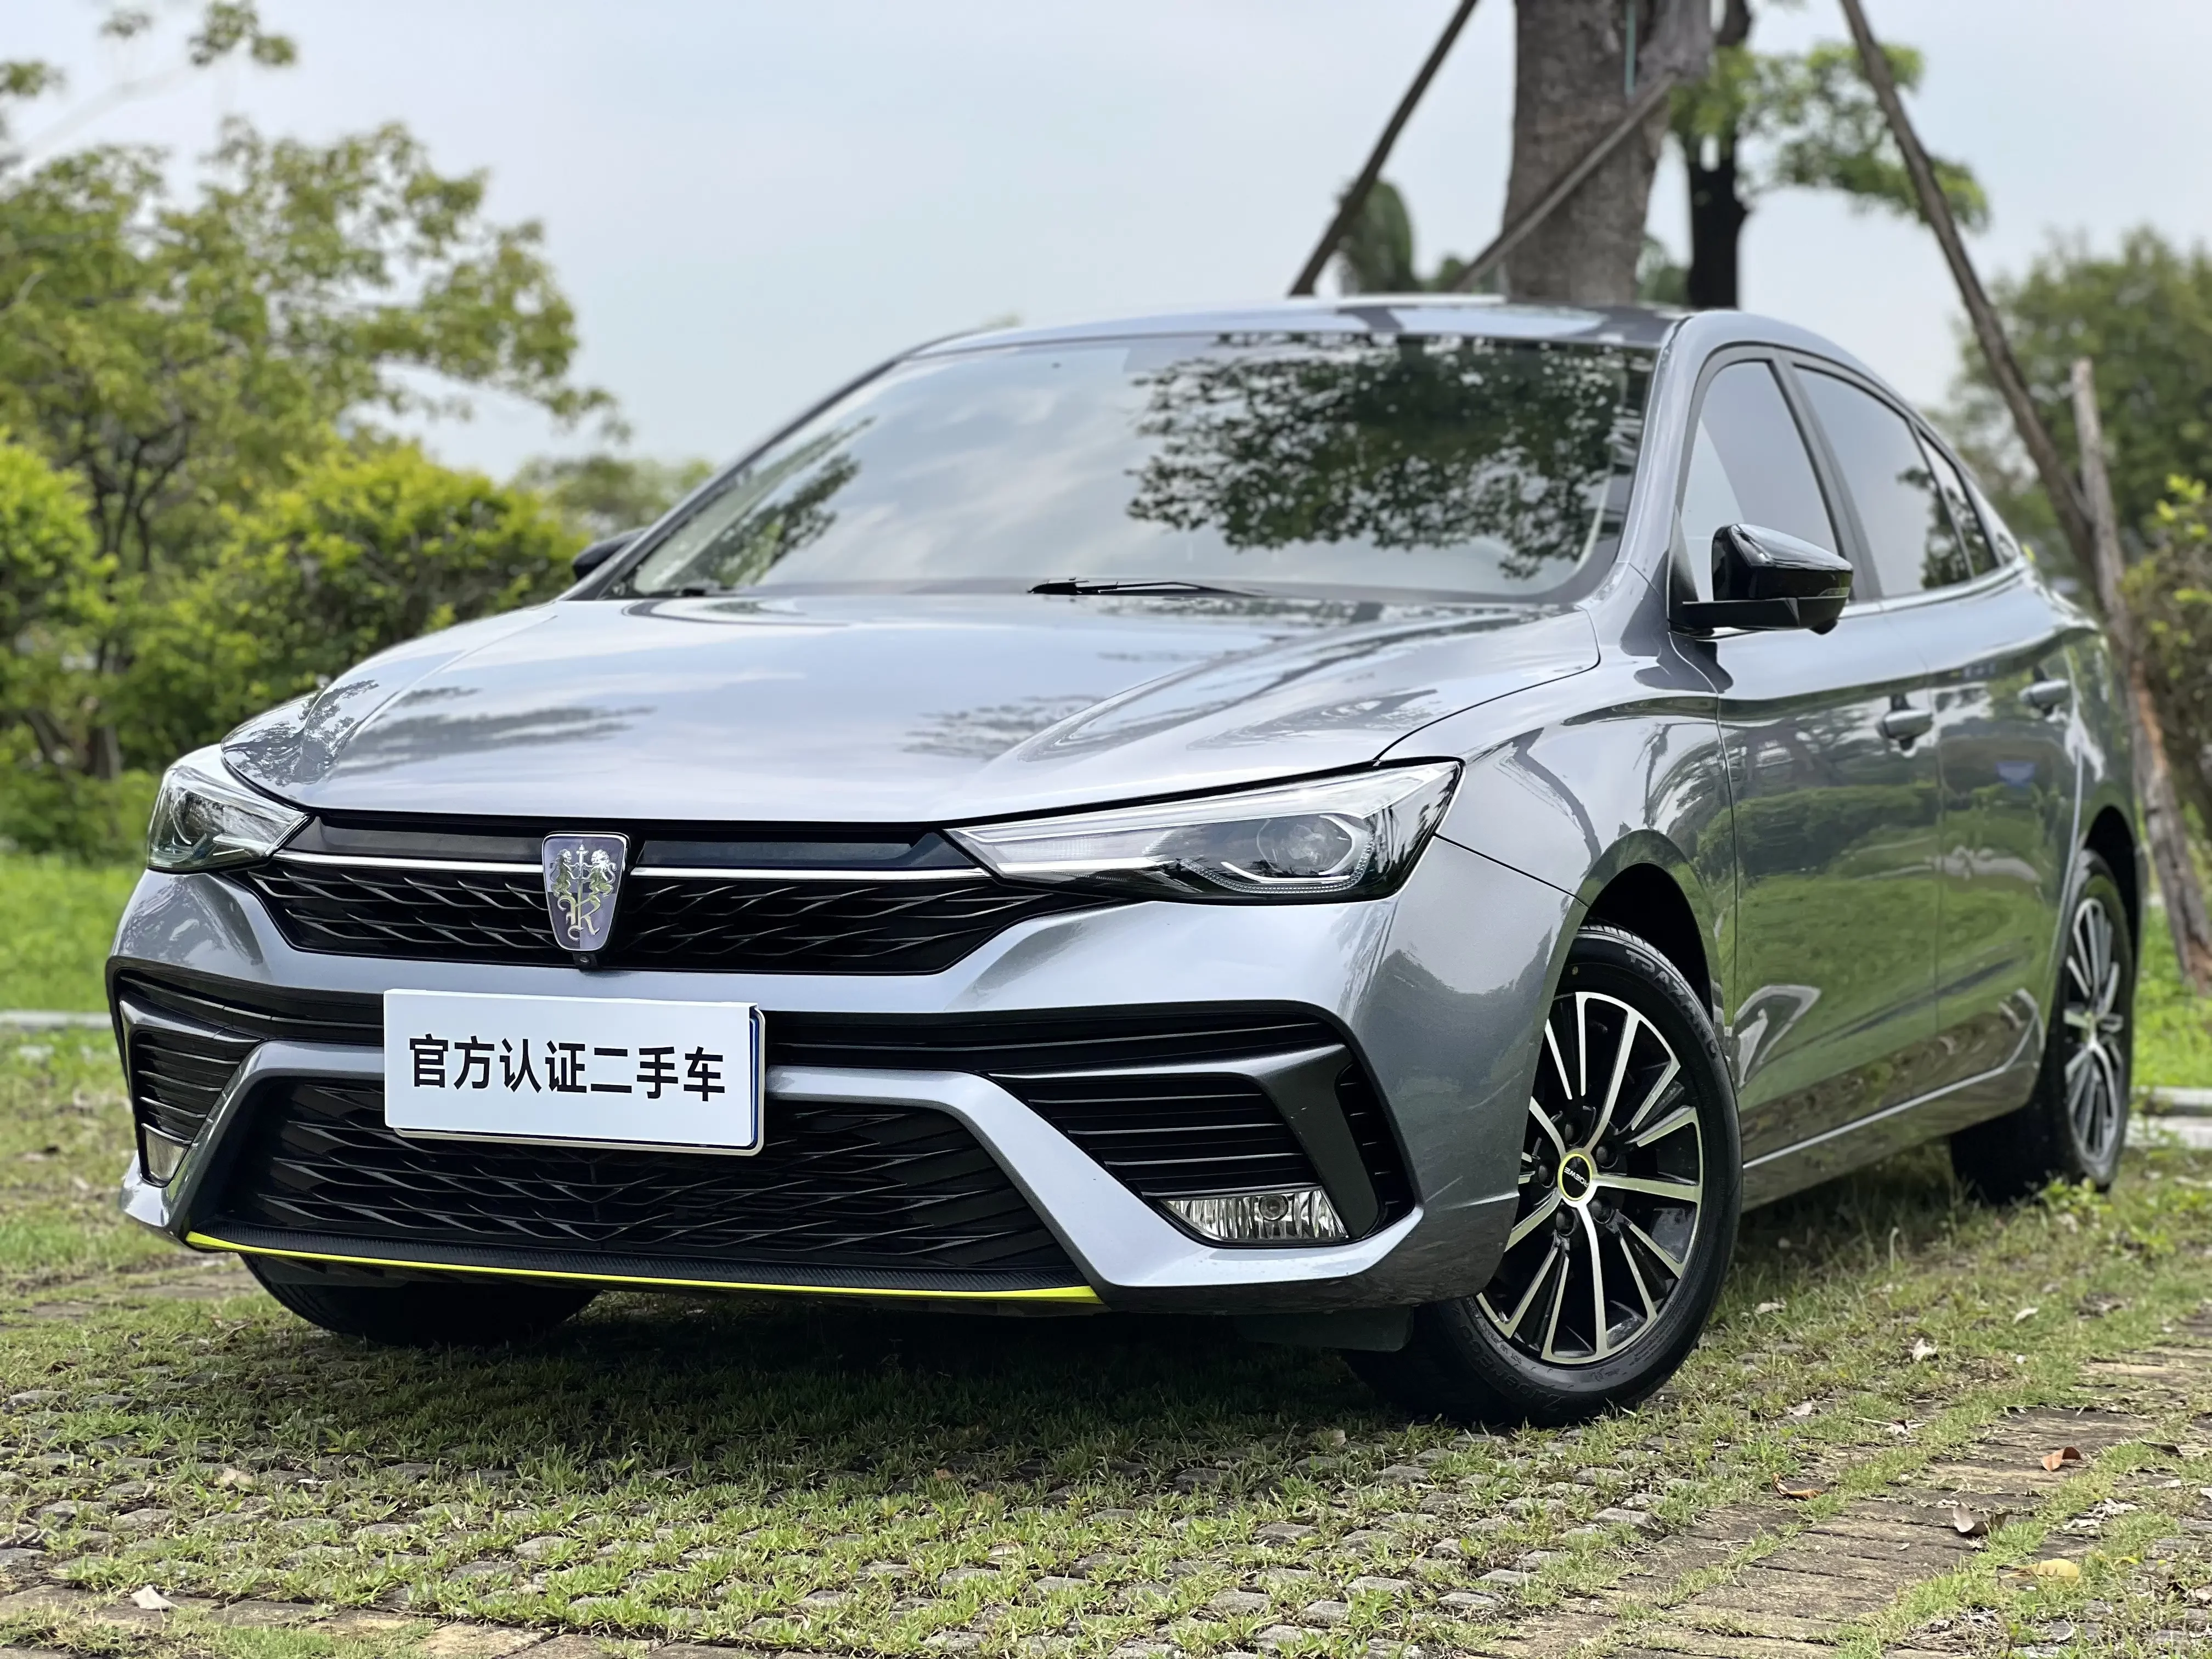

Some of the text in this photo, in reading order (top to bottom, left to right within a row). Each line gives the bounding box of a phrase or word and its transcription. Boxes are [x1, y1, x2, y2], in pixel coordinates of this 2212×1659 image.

[409, 1034, 725, 1102] 官方认证二手车
[1564, 1166, 1589, 1188] ROEWE
